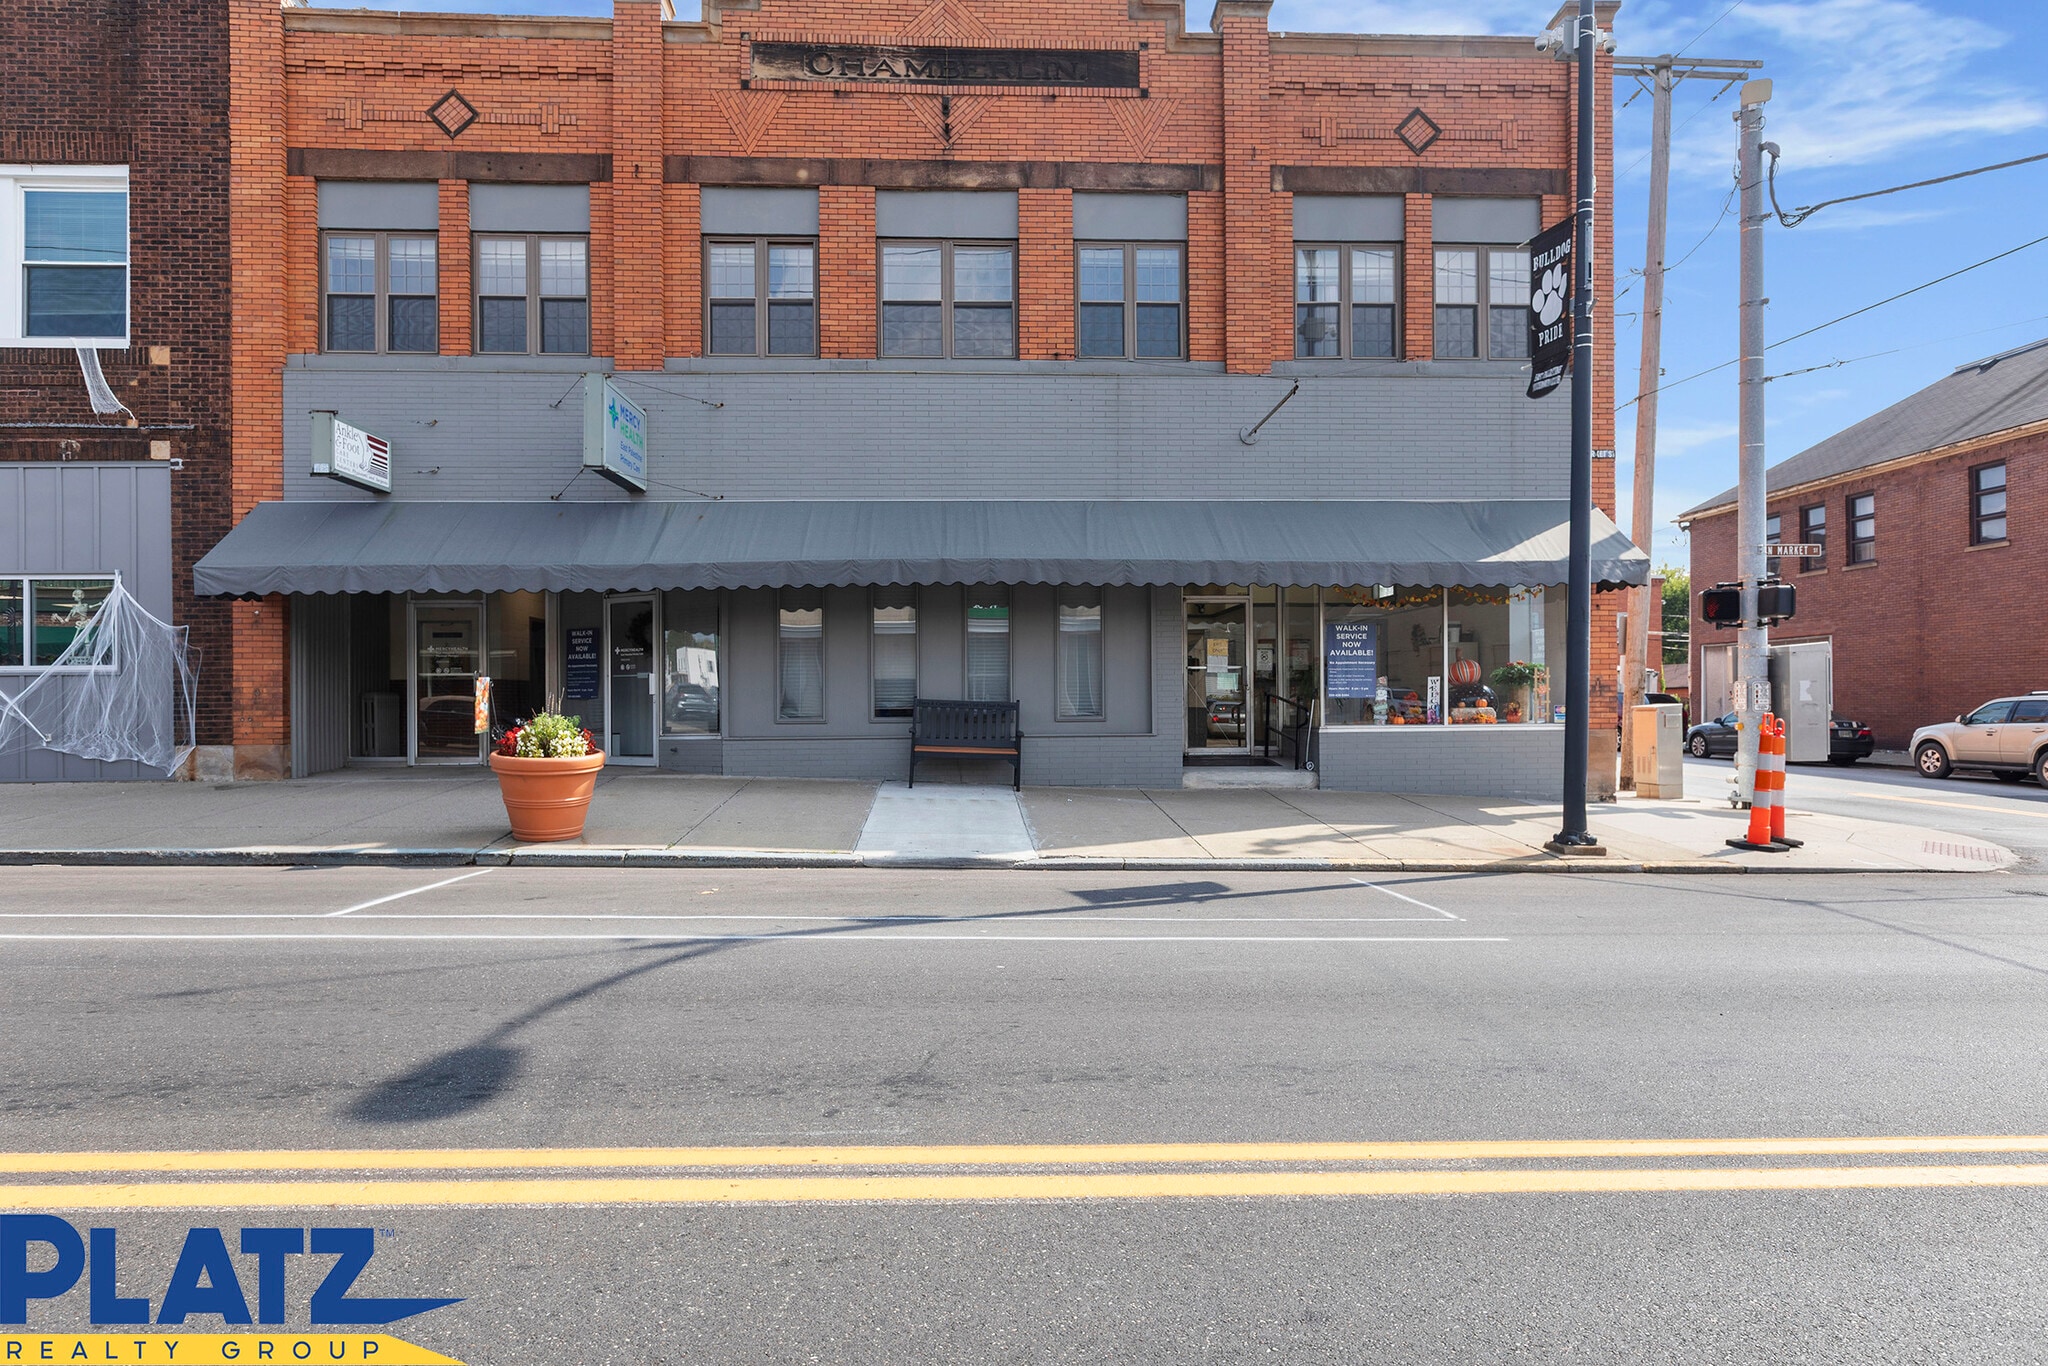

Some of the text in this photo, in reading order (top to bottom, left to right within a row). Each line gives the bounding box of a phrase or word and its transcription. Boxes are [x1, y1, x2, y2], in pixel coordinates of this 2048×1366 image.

[1533, 239, 1571, 271] BULLDOG
[1538, 323, 1563, 347] PRIDE
[620, 404, 640, 431] MERCY
[336, 424, 359, 442] Ankle
[620, 421, 643, 449] HEALTH
[1778, 546, 1808, 554] MARKET
